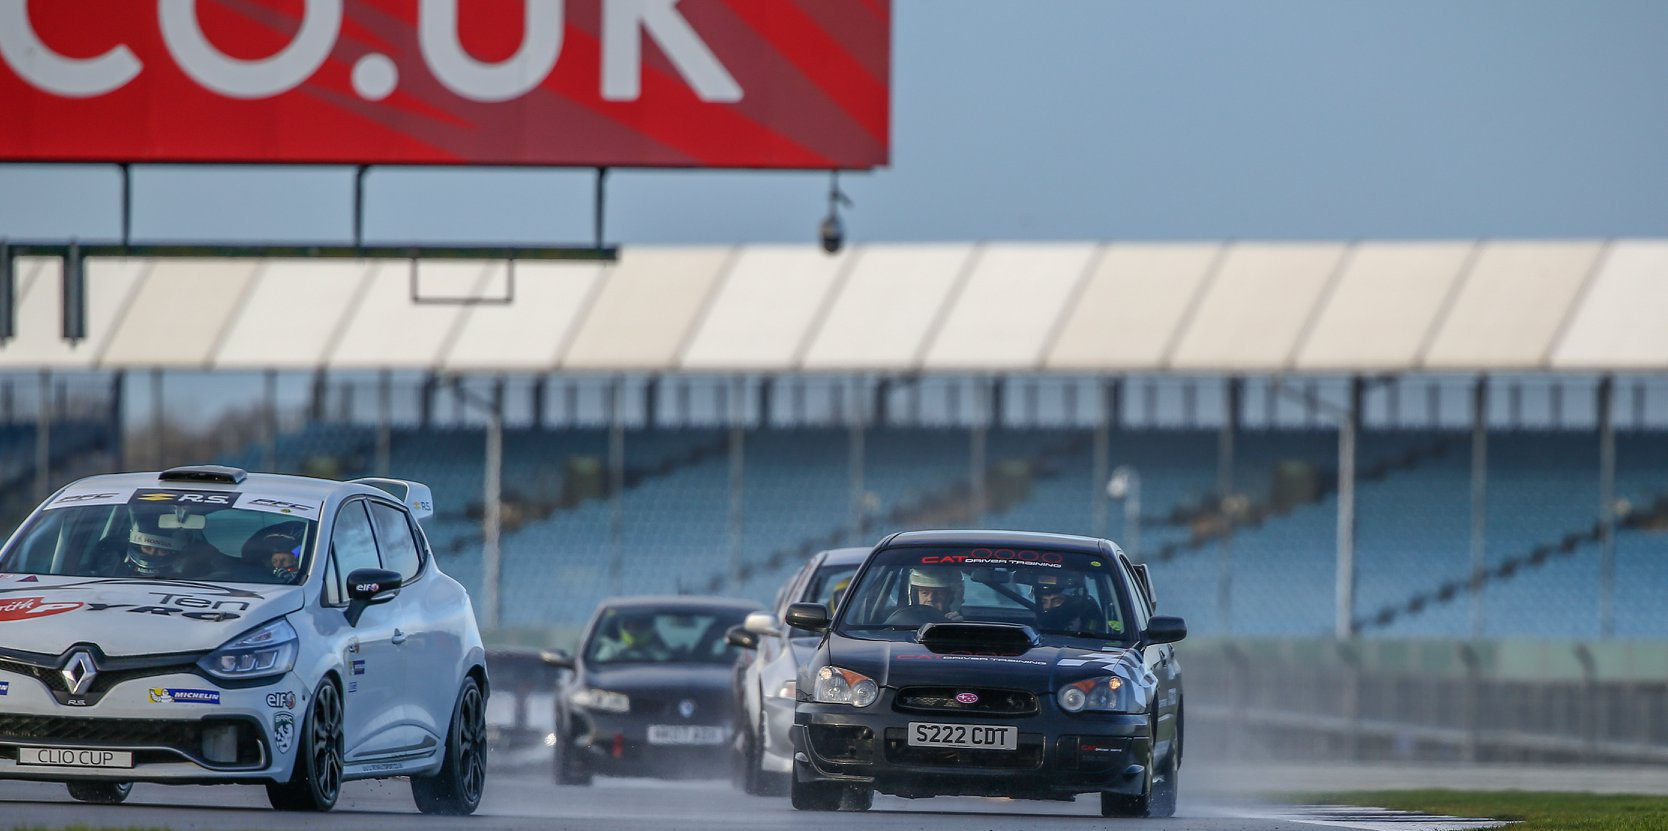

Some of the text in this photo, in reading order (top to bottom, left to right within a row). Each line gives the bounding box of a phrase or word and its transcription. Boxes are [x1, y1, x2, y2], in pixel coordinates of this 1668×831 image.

[921, 555, 969, 564] CAT
[1009, 559, 1062, 568] TRAINING
[356, 583, 371, 591] elf
[149, 592, 250, 611] Ten
[174, 692, 219, 700] MICHELIN
[266, 692, 287, 708] elf
[916, 724, 1009, 746] S222 CDT
[37, 749, 114, 765] CLIO CUP
